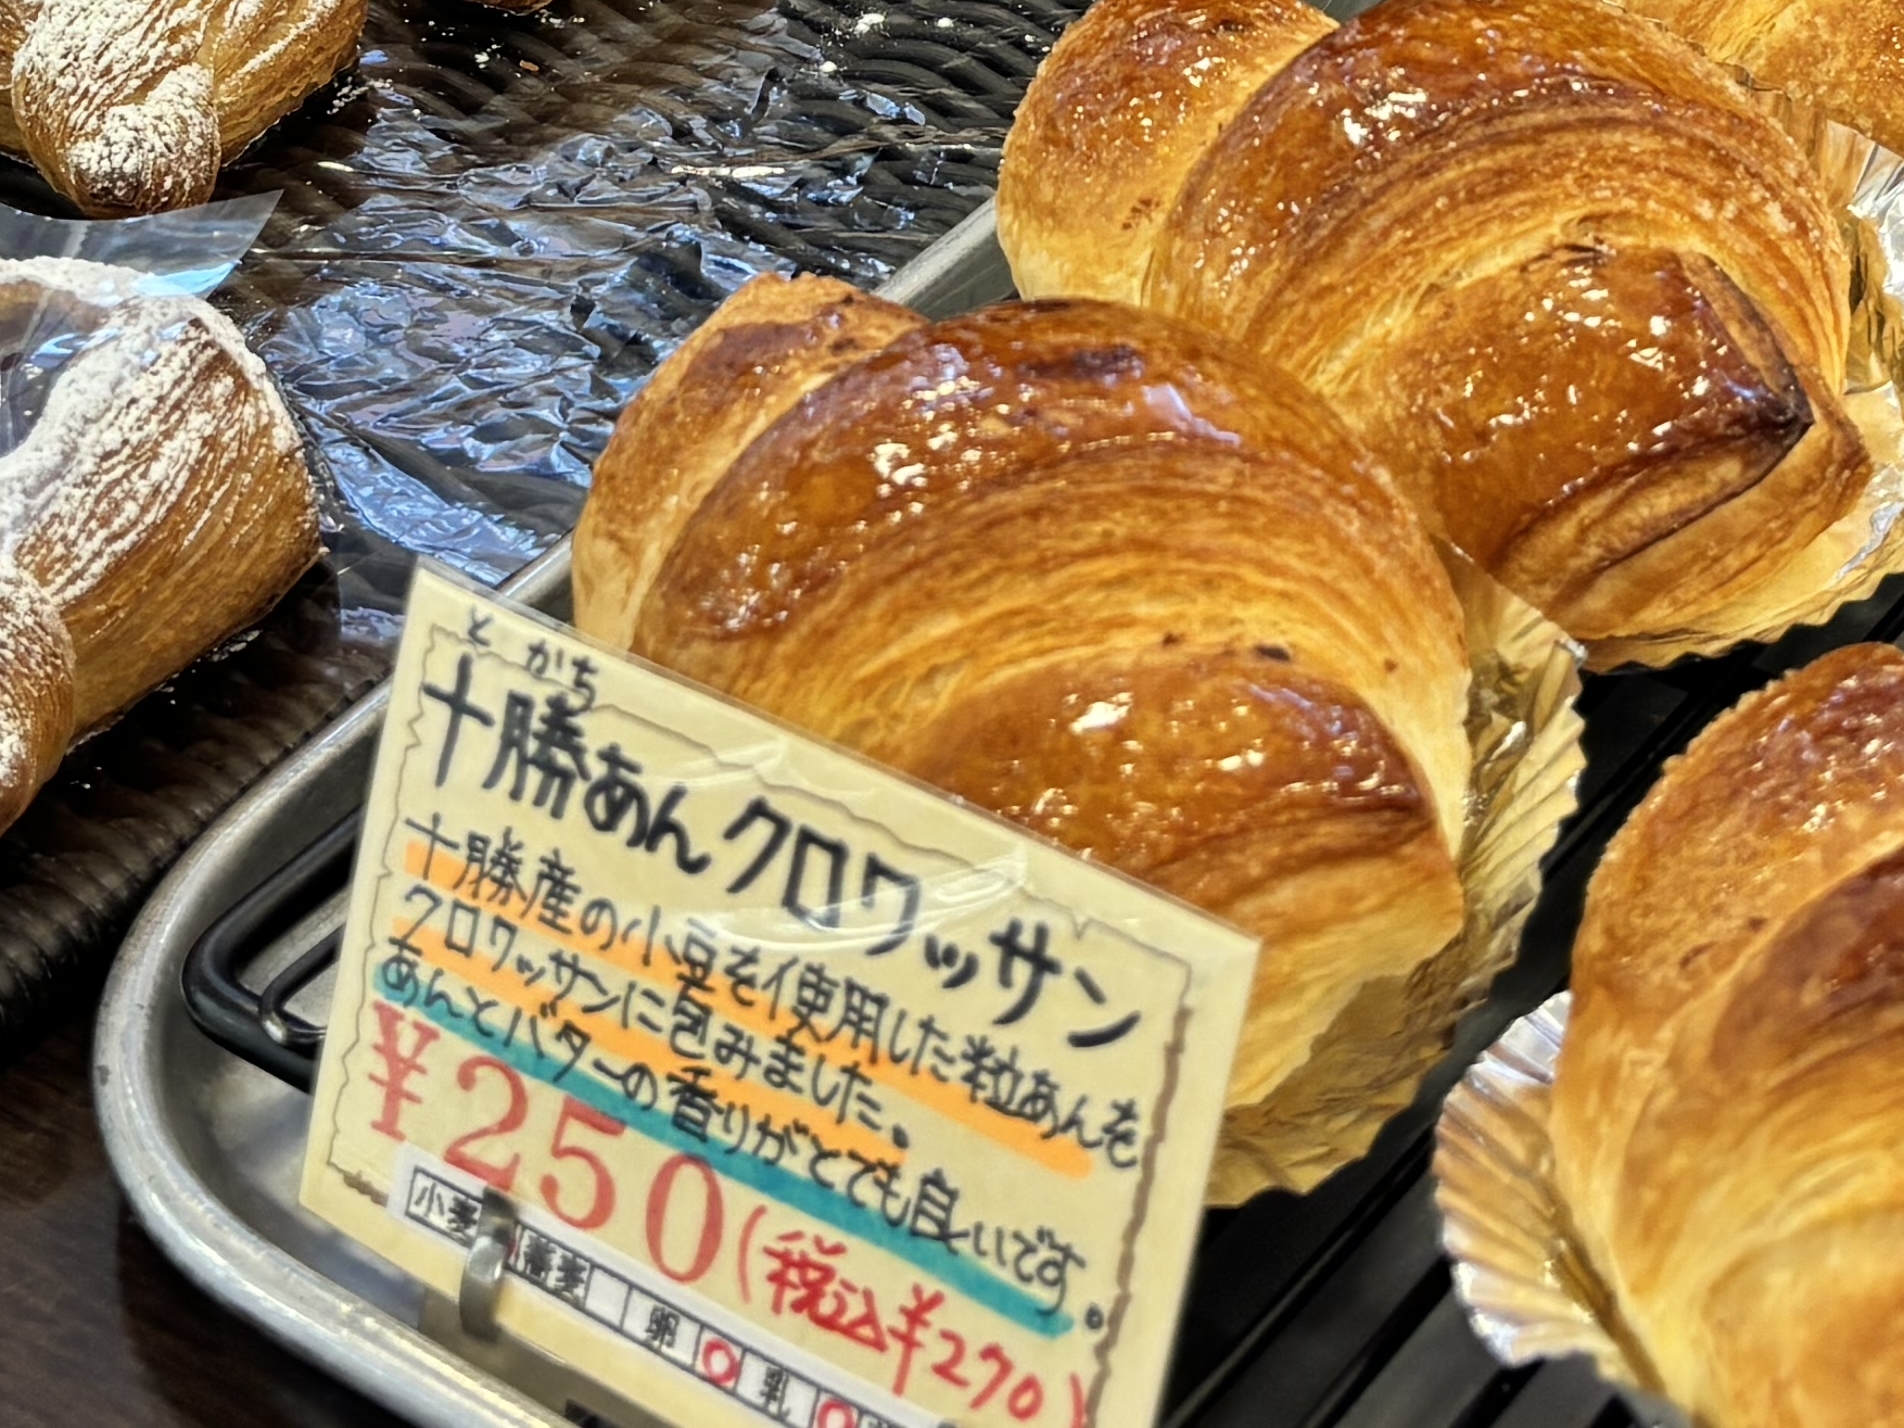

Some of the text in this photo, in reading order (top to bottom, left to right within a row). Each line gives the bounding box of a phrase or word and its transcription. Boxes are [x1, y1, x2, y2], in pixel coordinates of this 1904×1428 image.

[421, 652, 1141, 1048] 十勝あんクロワッサン
